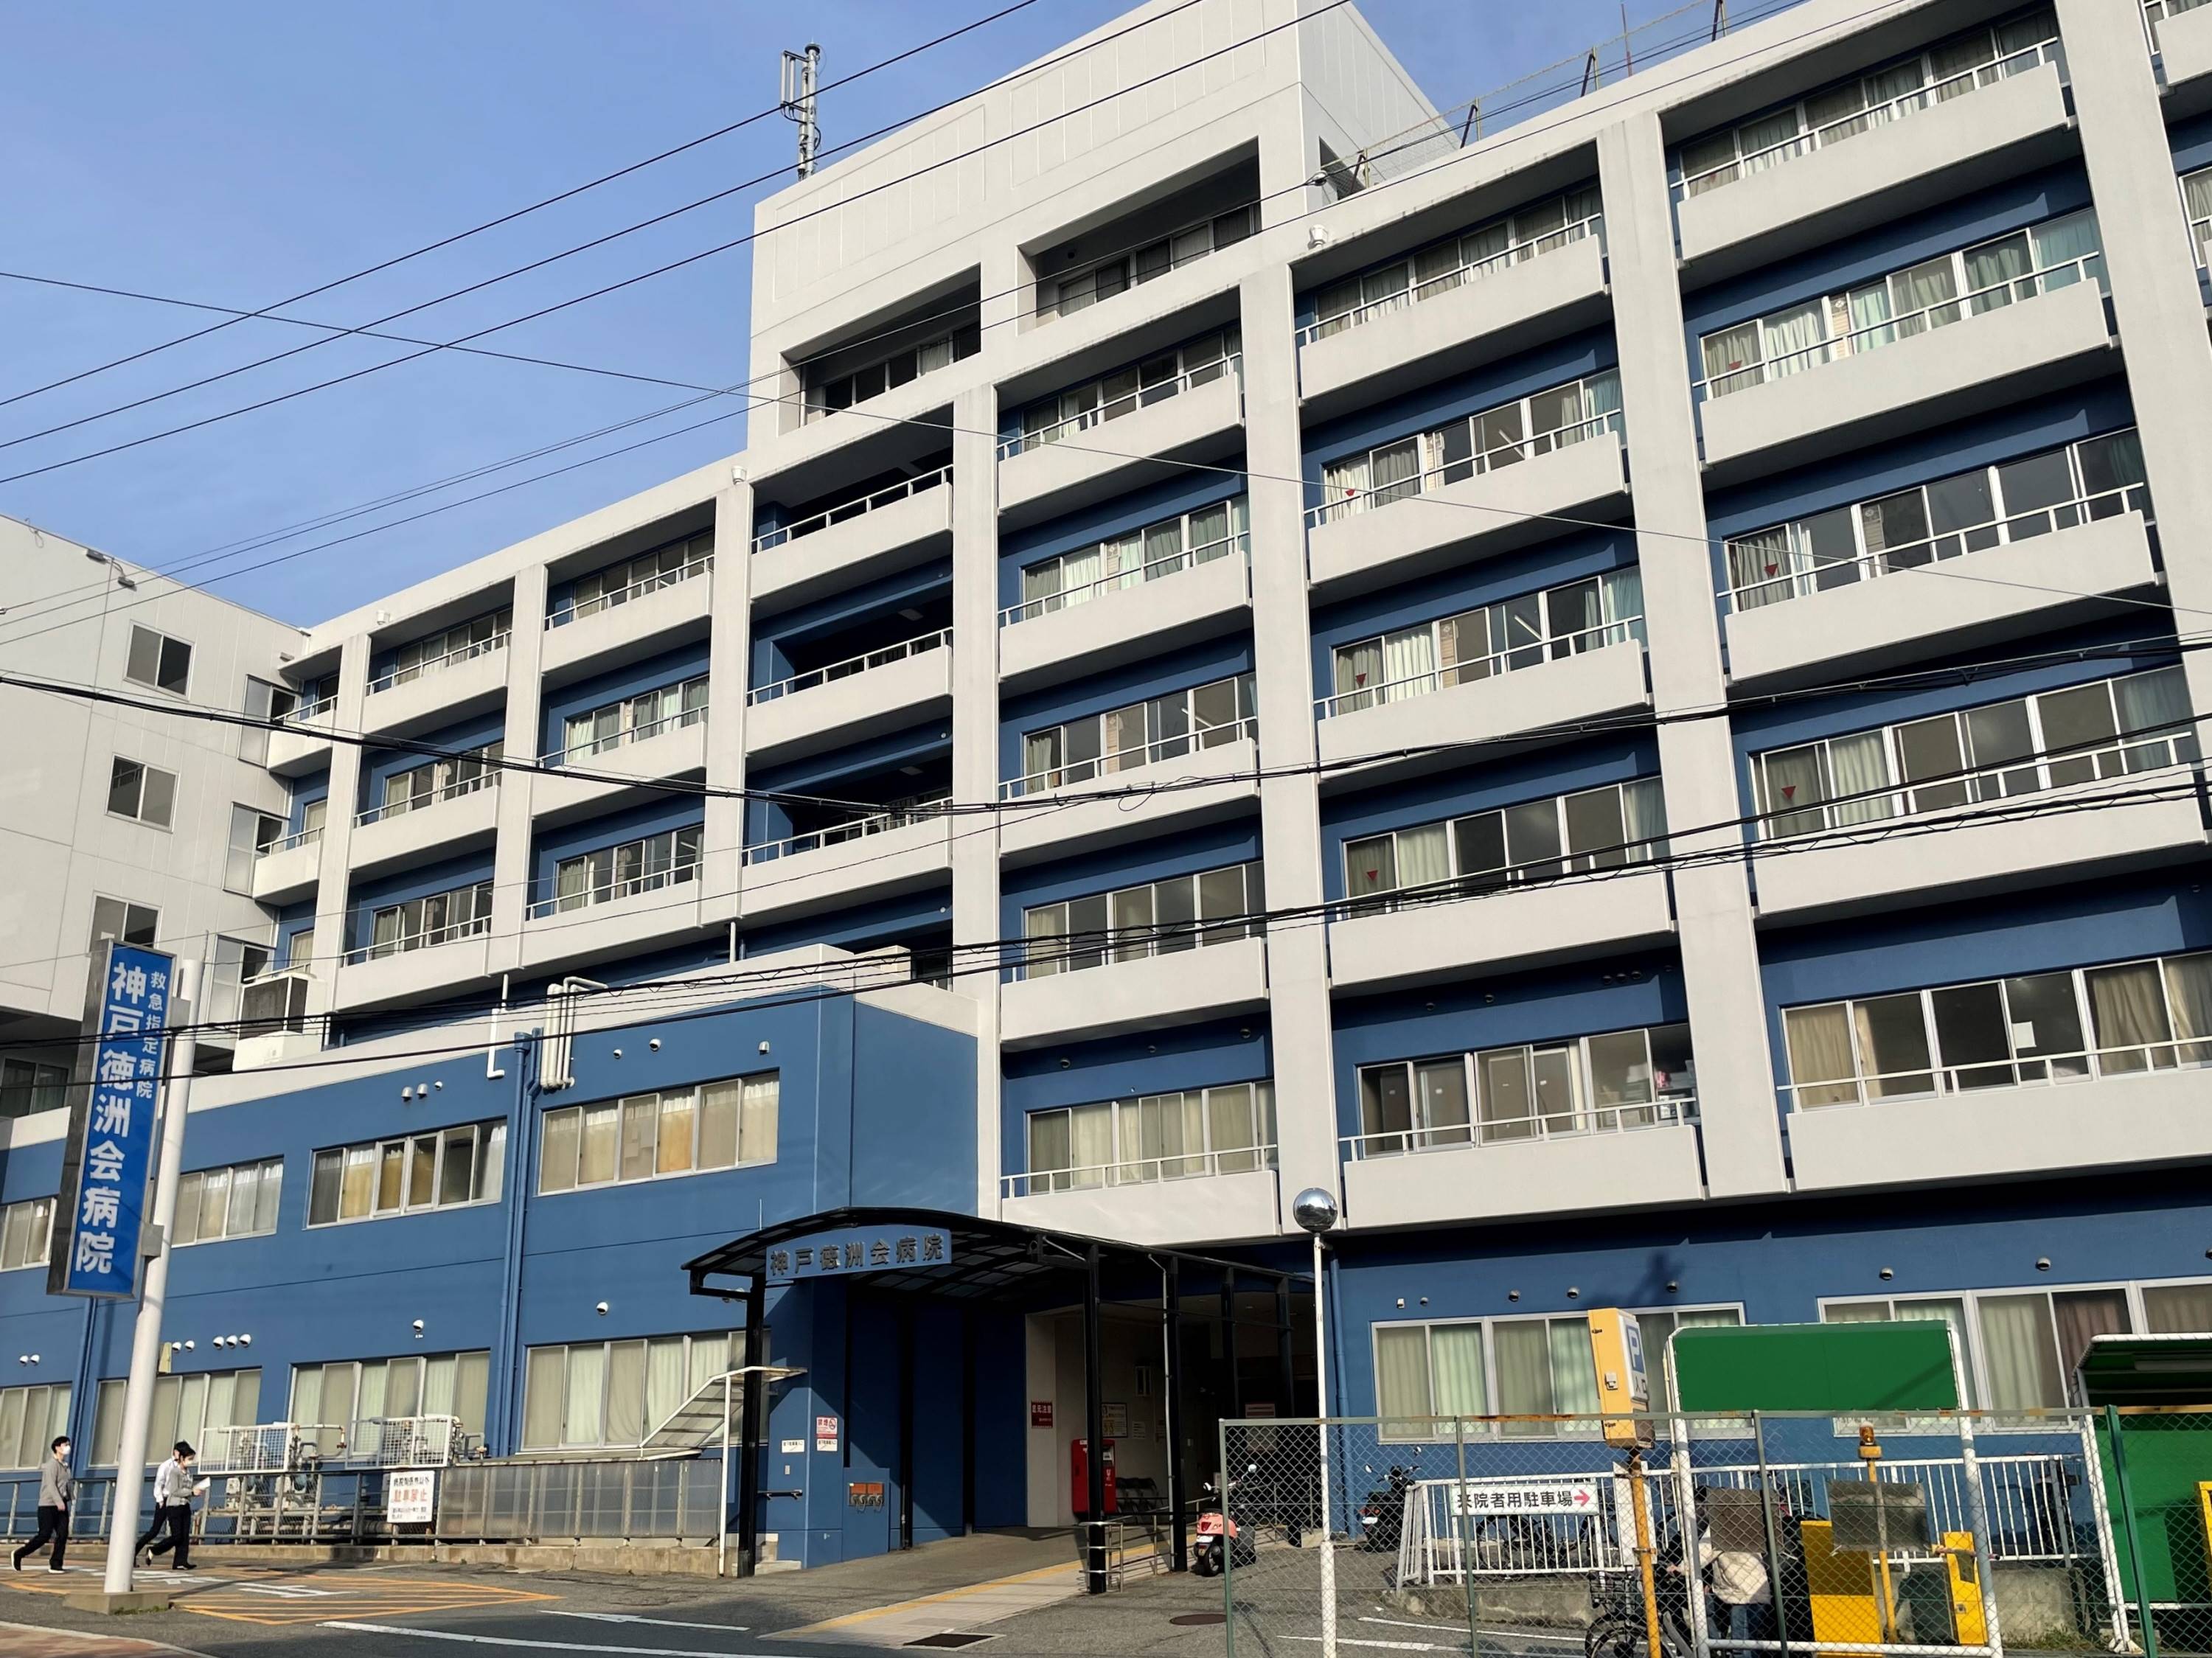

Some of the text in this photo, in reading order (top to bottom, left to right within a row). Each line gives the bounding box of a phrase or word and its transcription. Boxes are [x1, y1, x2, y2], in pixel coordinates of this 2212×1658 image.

[136, 971, 166, 1098] 救急指定病院
[75, 962, 147, 1274] 神戸徳洲会病院
[770, 1233, 945, 1276] 神戸徳洲会病院
[1627, 1328, 1641, 1368] P
[1634, 1376, 1647, 1394] 入口
[1457, 1490, 1573, 1509] 来院者用駐車場
